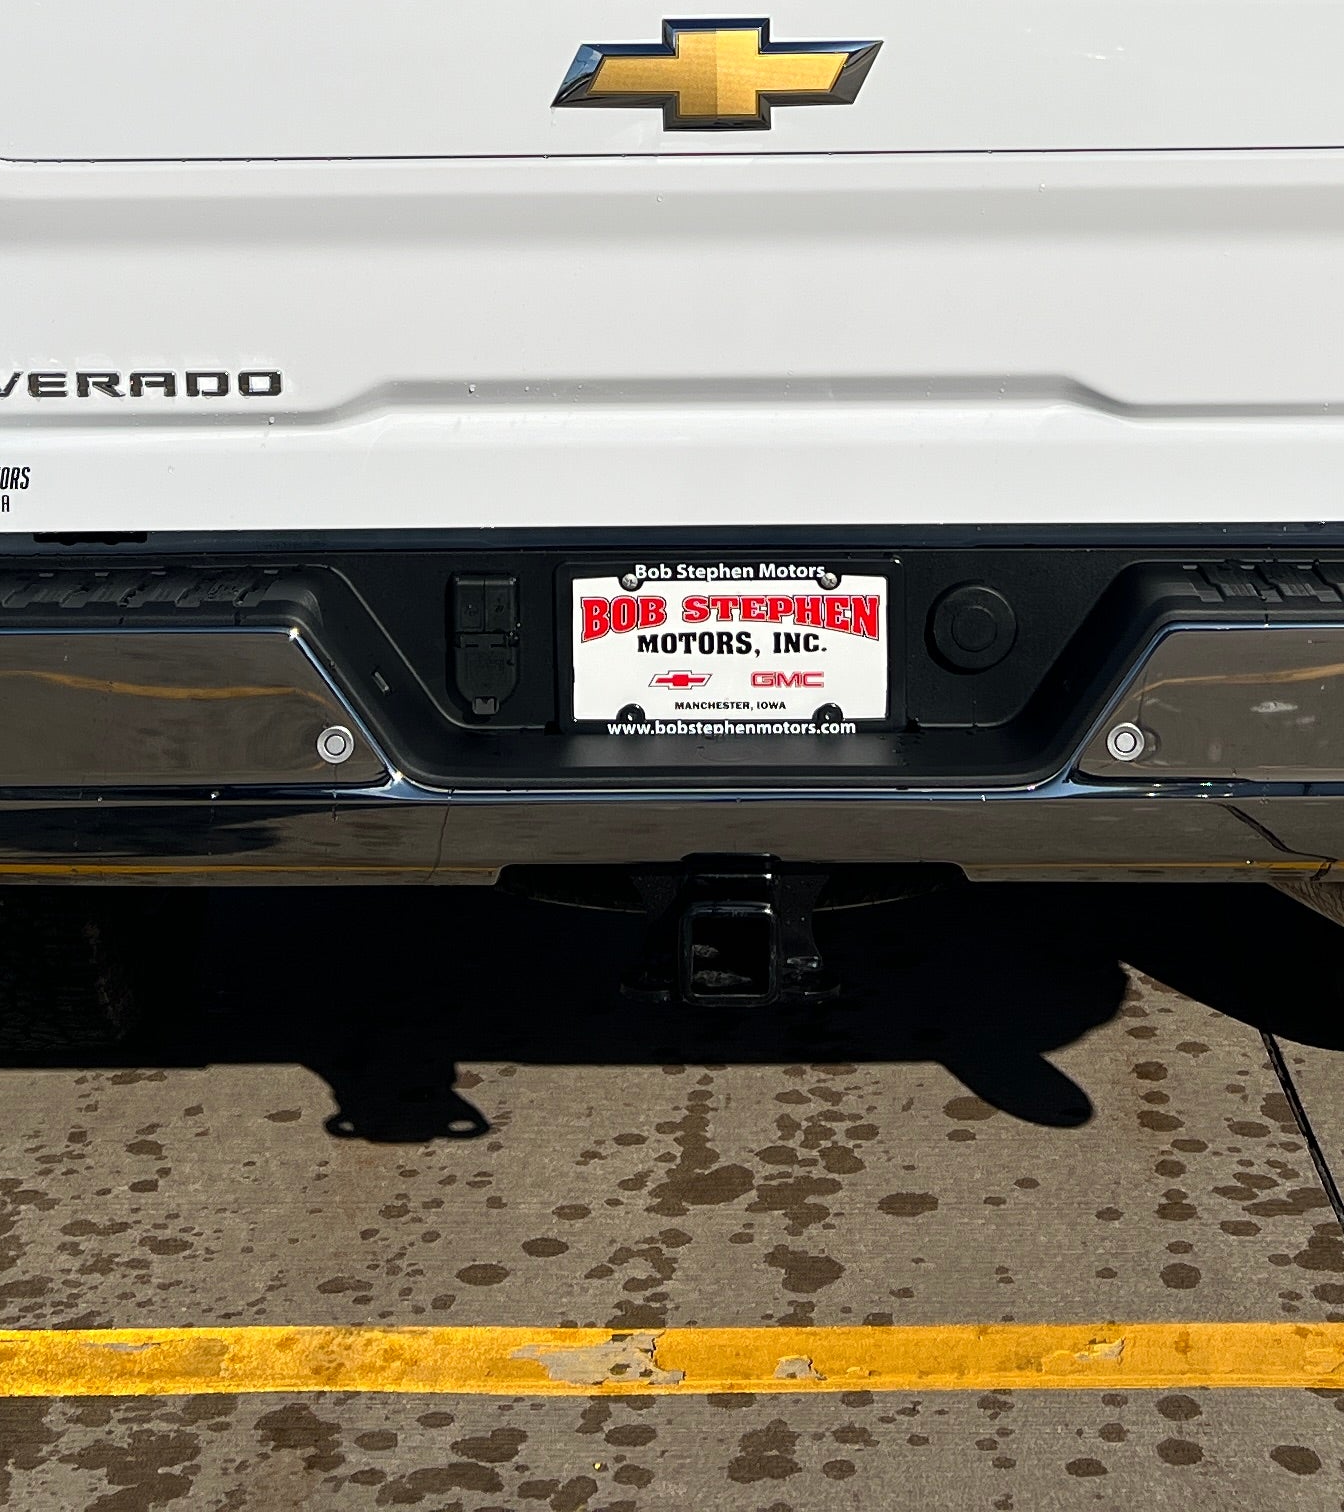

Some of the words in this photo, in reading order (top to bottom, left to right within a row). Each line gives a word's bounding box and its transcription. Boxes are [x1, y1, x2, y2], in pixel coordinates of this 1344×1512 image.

[635, 564, 672, 580] Bob
[676, 564, 755, 583] Stephen
[759, 563, 825, 579] Motors
[580, 595, 667, 643] BOB
[682, 594, 881, 641] STEPHEN
[636, 631, 761, 658] MOTORS,
[773, 631, 828, 653] INC.
[751, 671, 825, 688] GMC
[674, 701, 754, 711] MANCHESTER,
[756, 701, 787, 710] IOWA
[607, 720, 856, 735] www.bobstephenmotors.com
